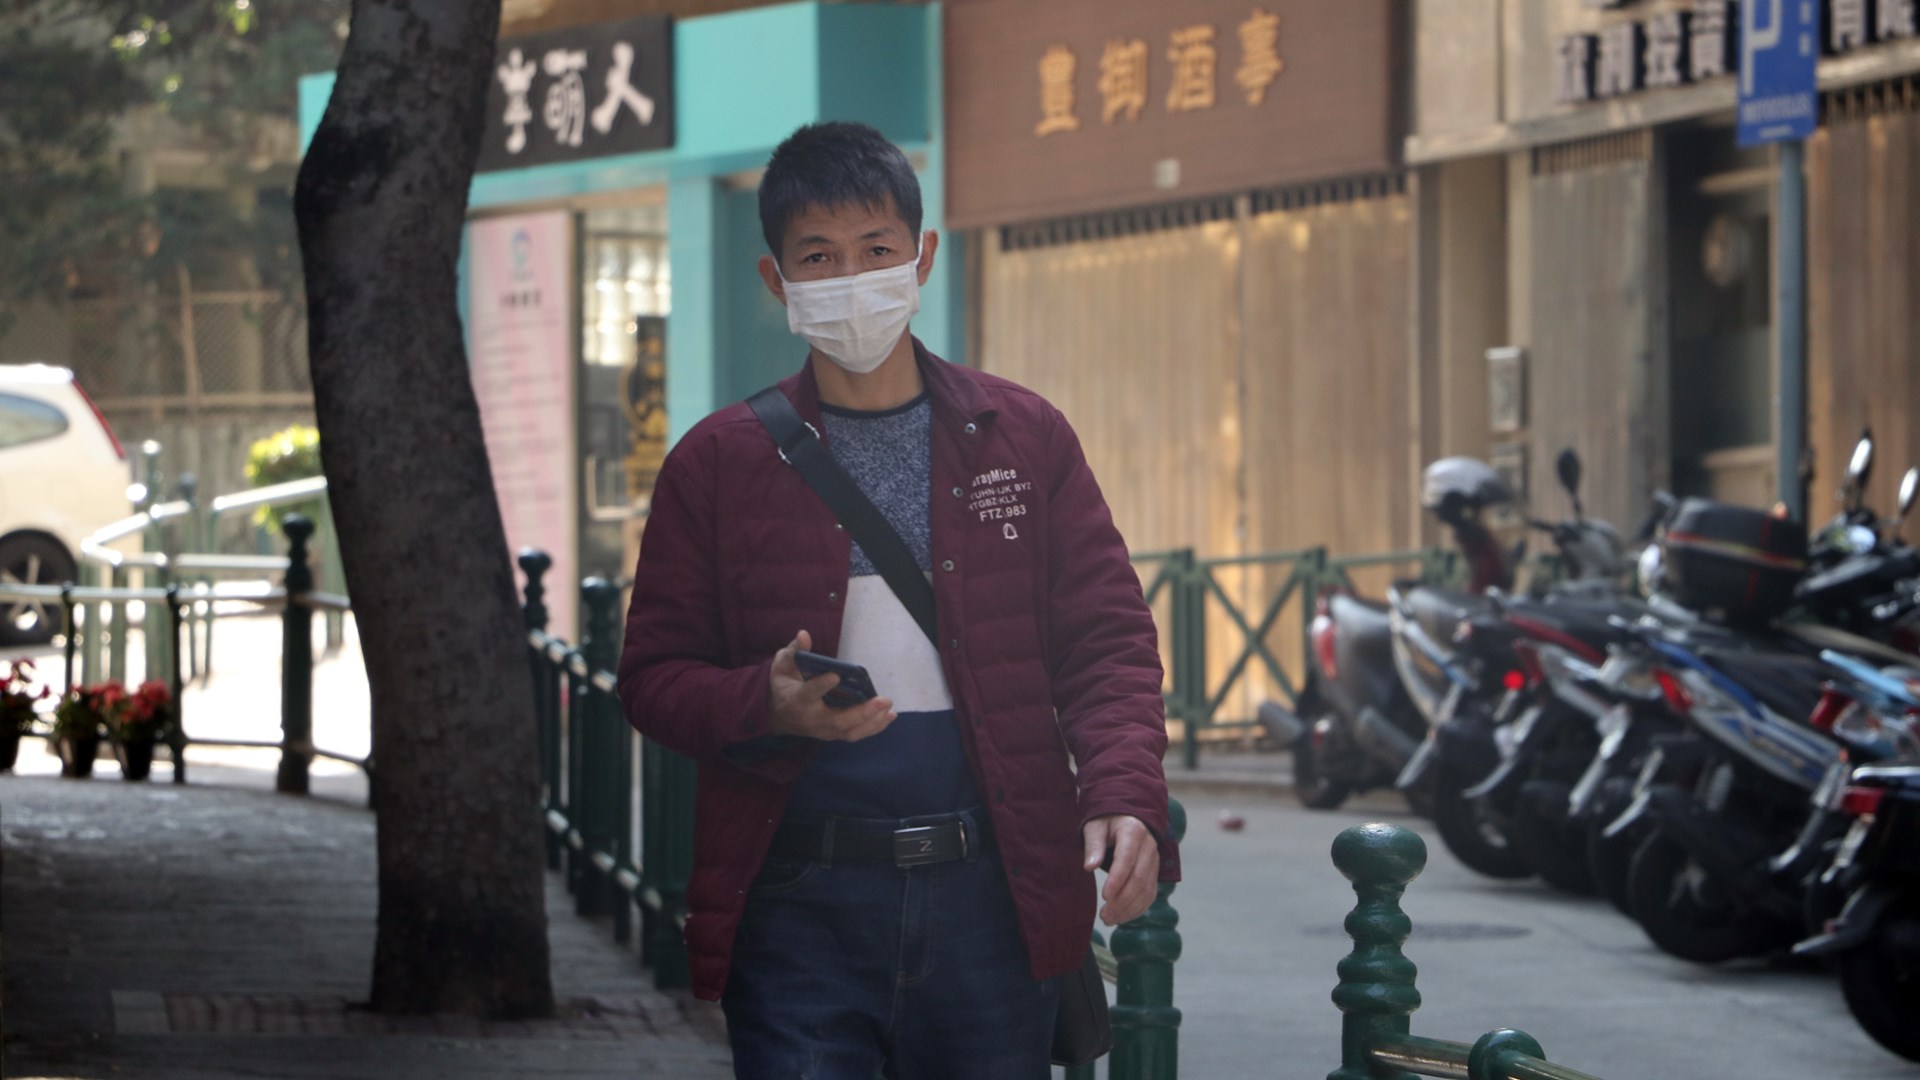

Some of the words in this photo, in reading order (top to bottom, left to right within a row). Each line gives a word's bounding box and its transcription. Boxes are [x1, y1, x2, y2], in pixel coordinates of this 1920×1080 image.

[1743, 0, 1782, 96] P
[979, 507, 1002, 521] FTZ
[1005, 503, 1026, 517] 983
